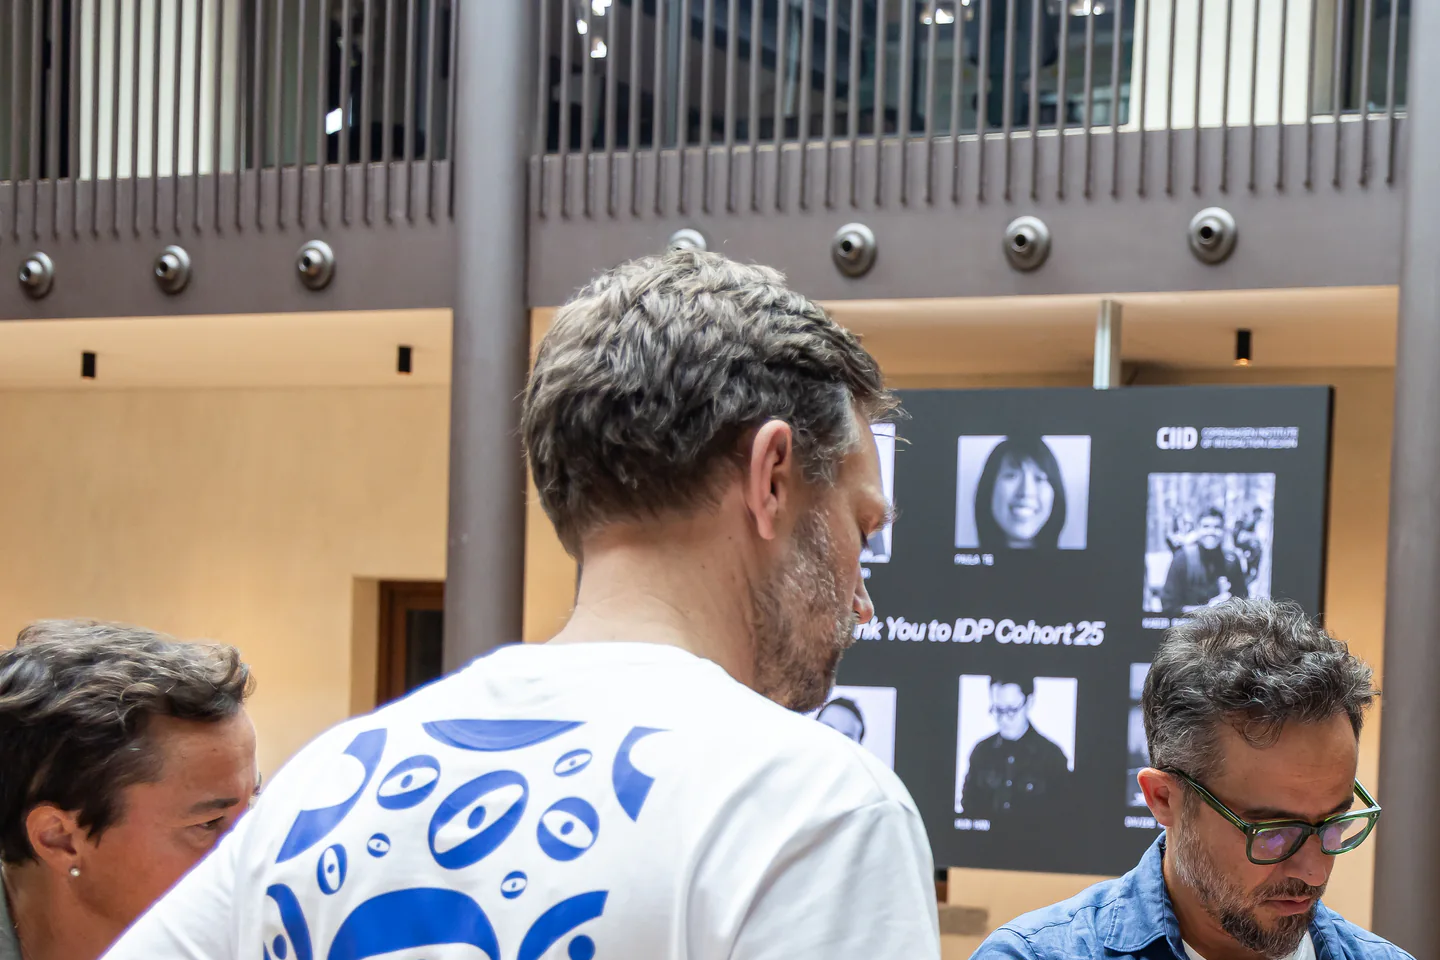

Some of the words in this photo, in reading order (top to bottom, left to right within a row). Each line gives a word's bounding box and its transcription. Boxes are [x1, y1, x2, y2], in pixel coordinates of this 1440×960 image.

[1157, 426, 1198, 449] CIID
[886, 616, 927, 641] You
[928, 619, 952, 642] to
[952, 618, 995, 643] IDP
[995, 618, 1075, 645] Cohort
[1073, 620, 1106, 646] 25
